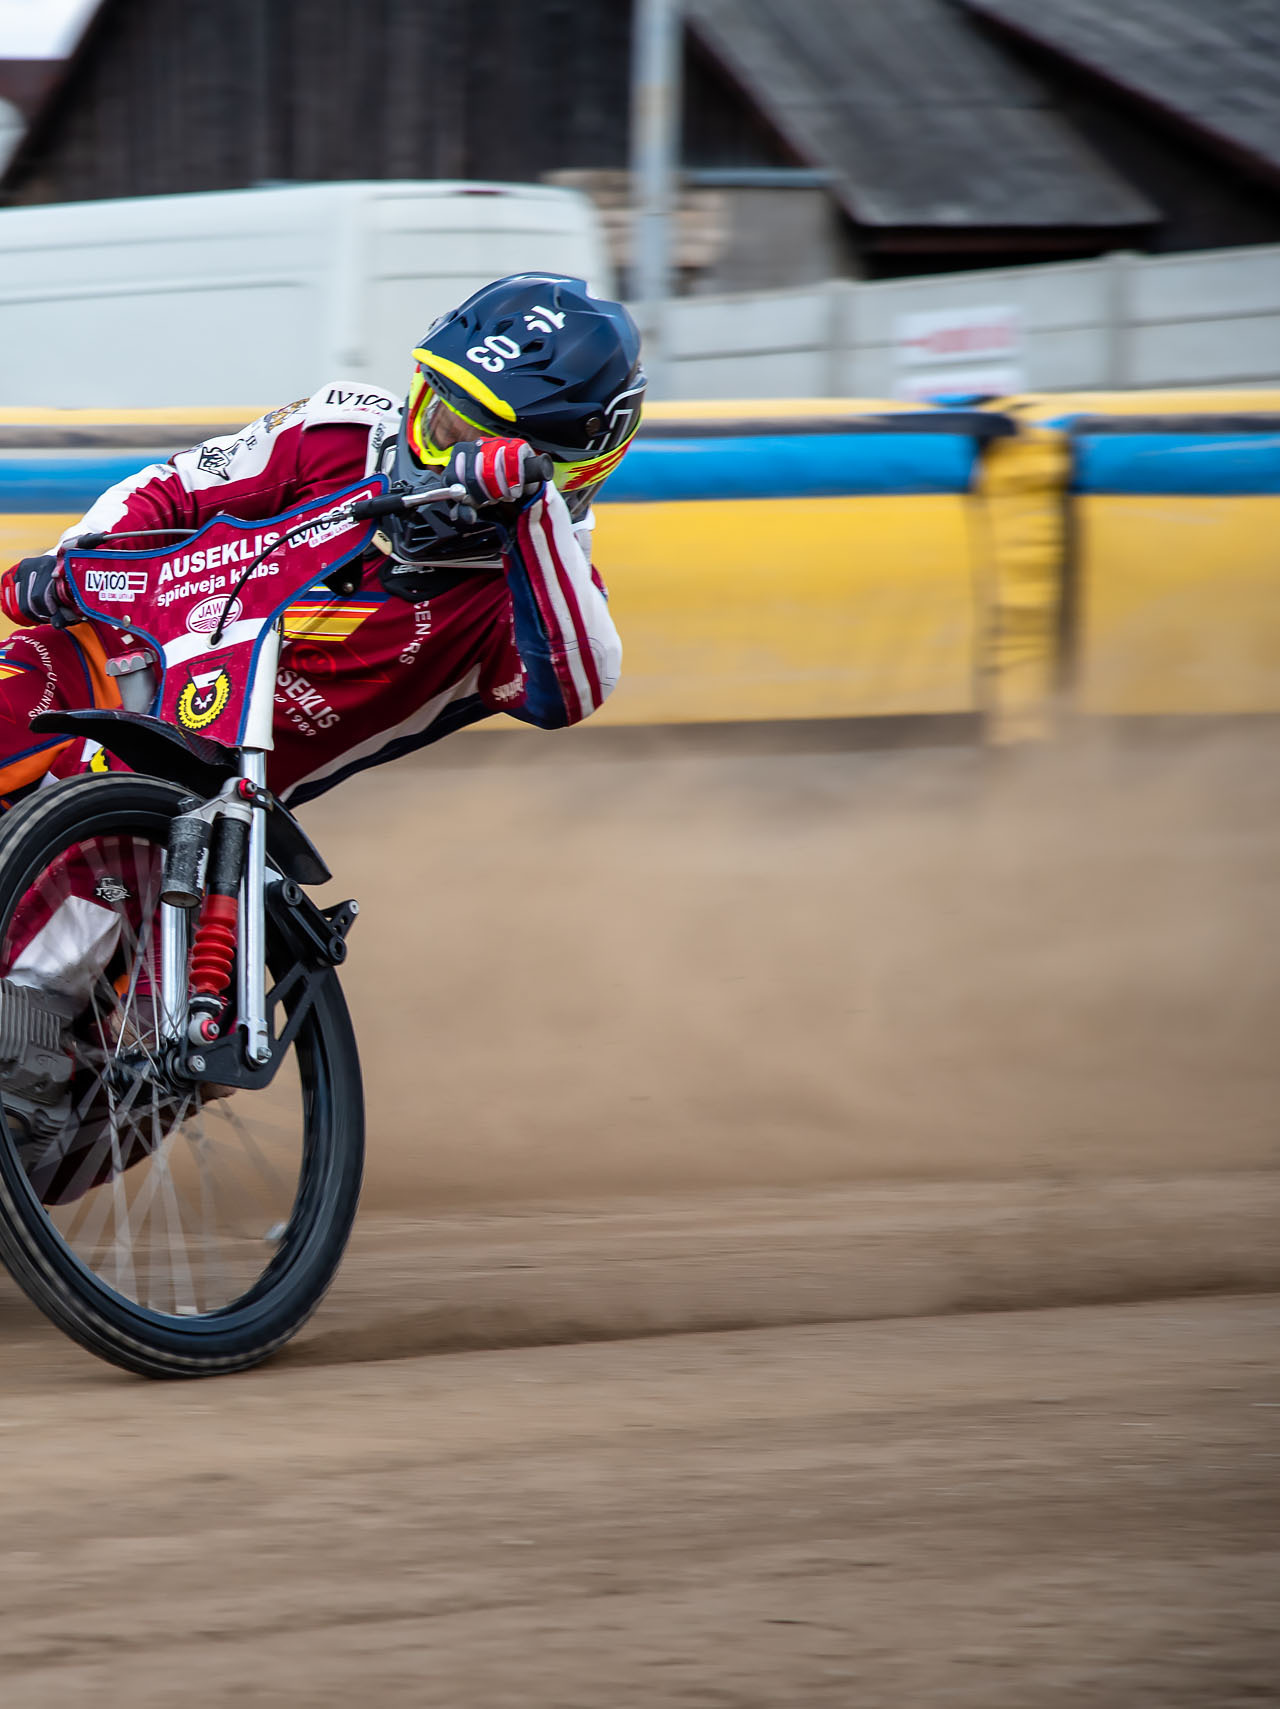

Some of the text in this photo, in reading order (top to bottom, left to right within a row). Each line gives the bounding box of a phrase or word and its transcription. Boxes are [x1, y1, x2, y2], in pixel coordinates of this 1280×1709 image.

[87, 573, 126, 590] LV100
[158, 532, 280, 586] AUSEKLIS
[198, 598, 228, 619] JAW
[399, 600, 432, 665] CENRS
[276, 668, 340, 729] SEKLIS
